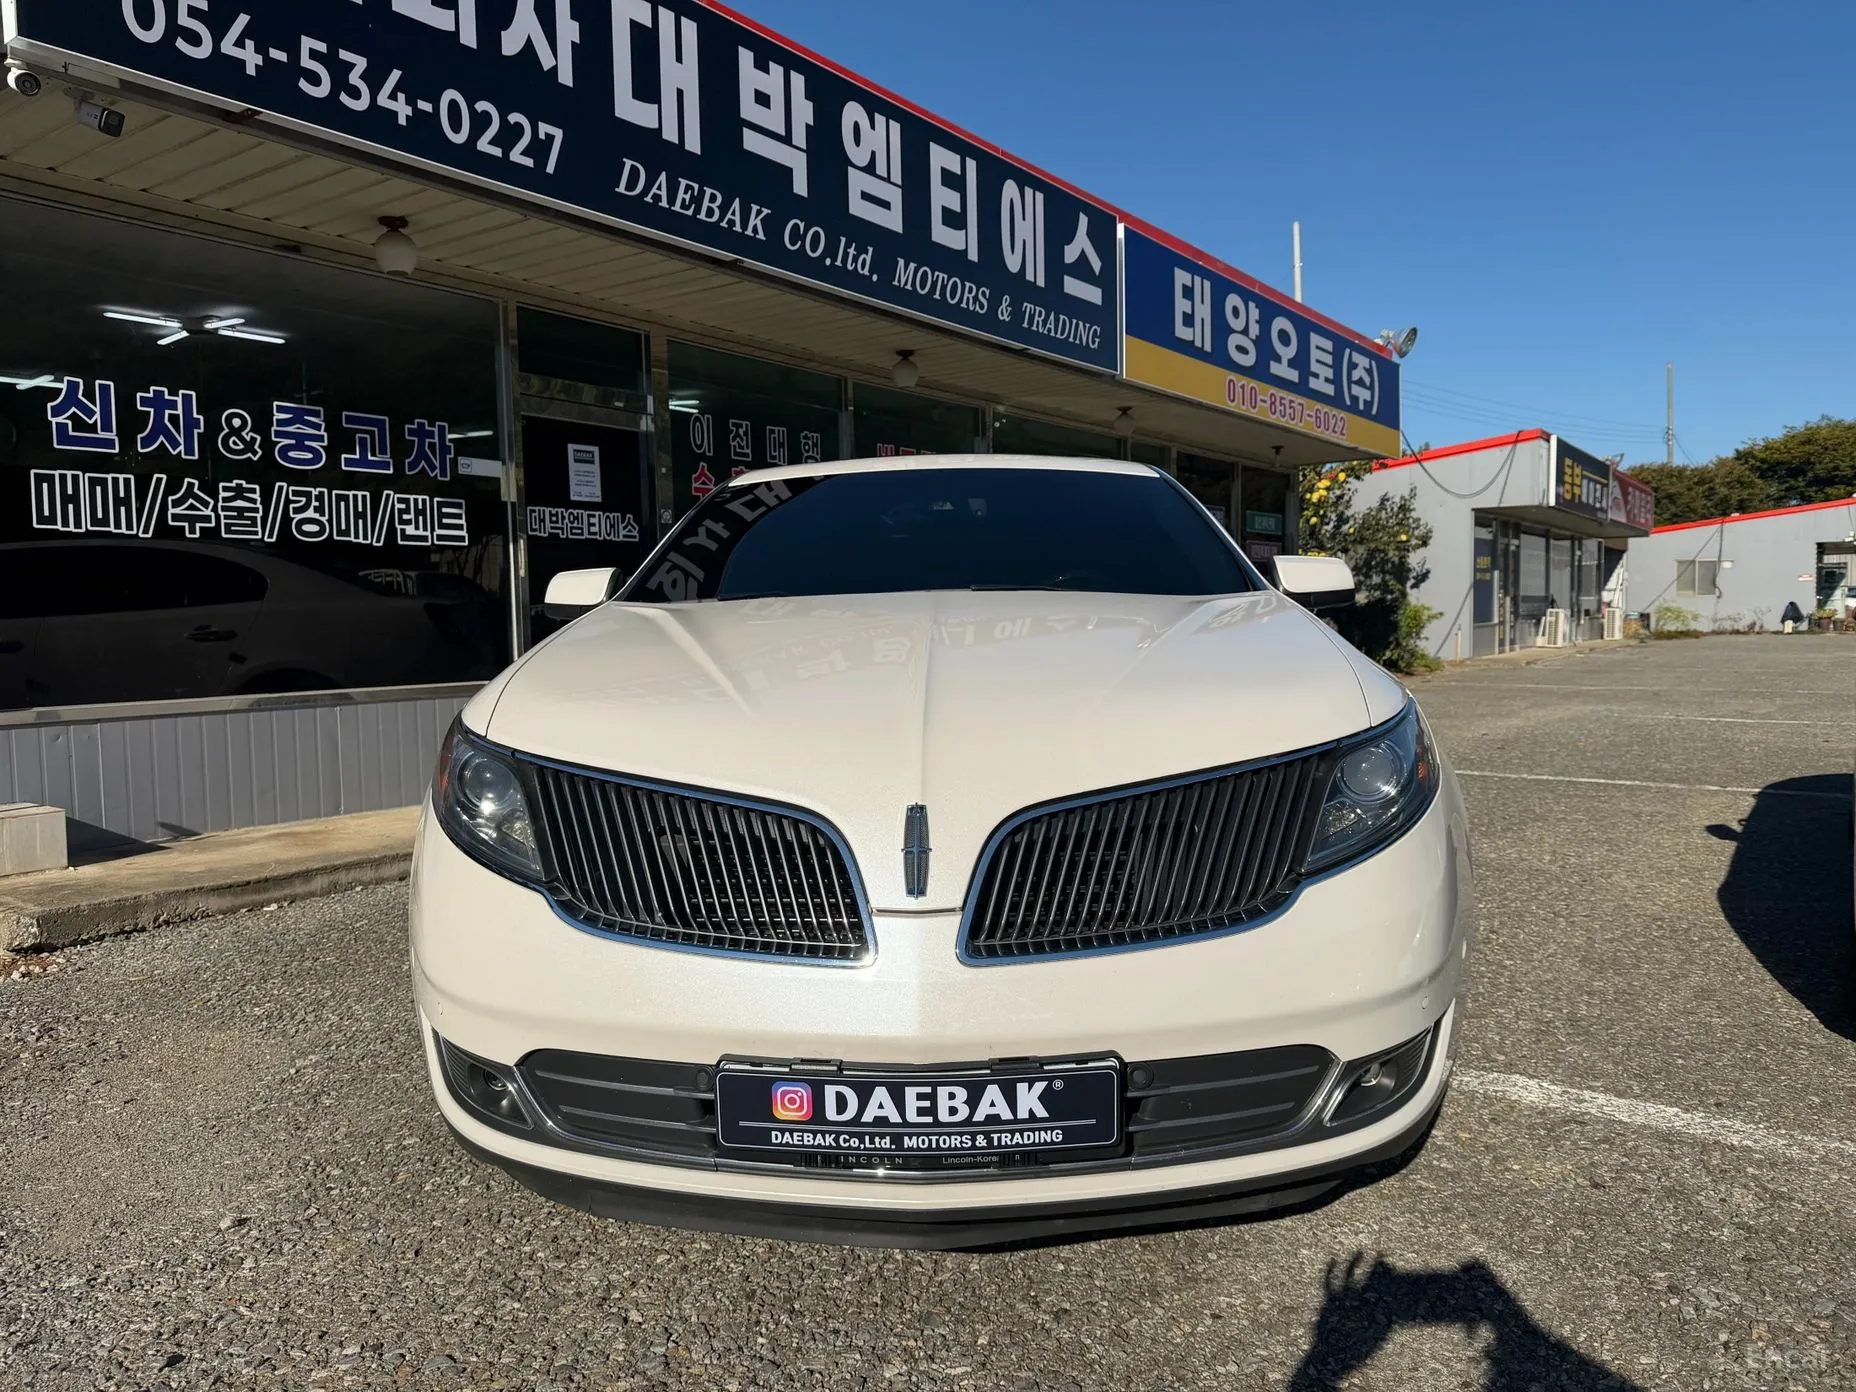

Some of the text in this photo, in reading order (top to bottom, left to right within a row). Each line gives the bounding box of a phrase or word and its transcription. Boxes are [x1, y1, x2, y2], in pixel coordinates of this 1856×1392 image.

[121, 0, 564, 174] 054-534-0227
[614, 157, 772, 241] DAEBAK
[892, 257, 991, 315] MOTORS
[997, 295, 1012, 322] &
[1022, 302, 1102, 350] TRADING
[1174, 266, 1379, 415] 태양오토(주)
[1225, 375, 1348, 437] 010-8557-6022
[527, 505, 640, 542] 대박엠티에스
[771, 1131, 837, 1147] DAEBAK
[903, 1135, 973, 1149] MOTORS
[975, 1134, 988, 1147] &
[990, 1129, 1064, 1147] TRADING
